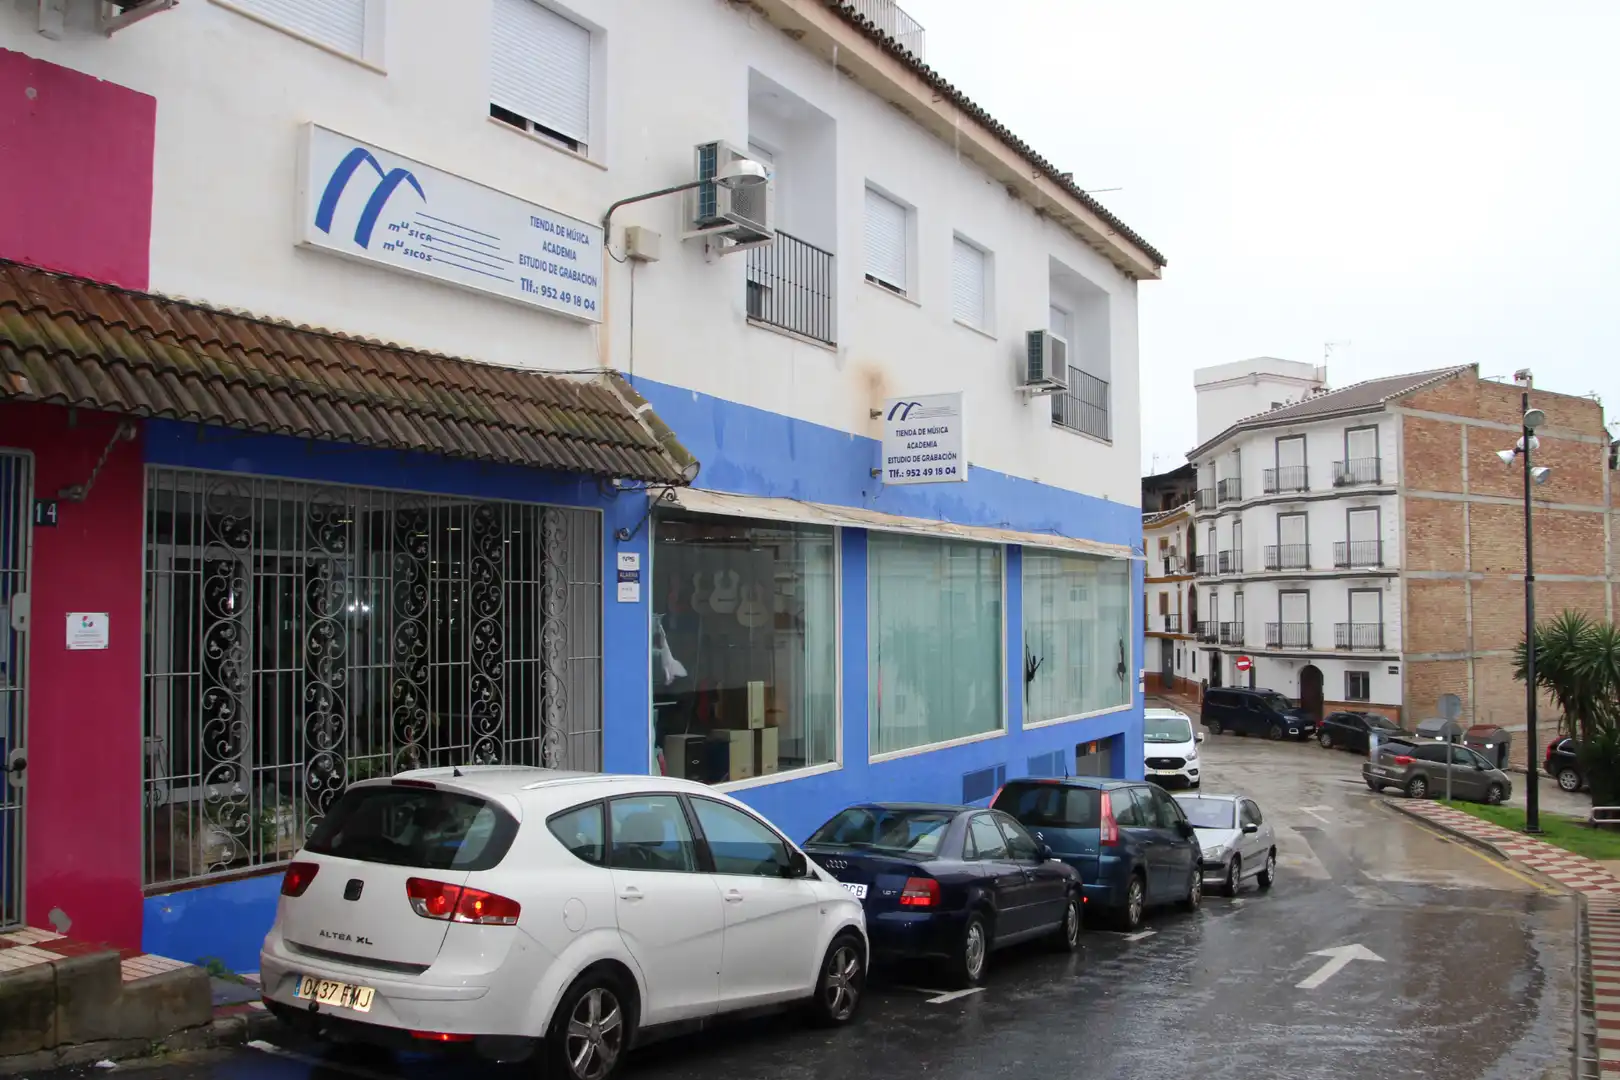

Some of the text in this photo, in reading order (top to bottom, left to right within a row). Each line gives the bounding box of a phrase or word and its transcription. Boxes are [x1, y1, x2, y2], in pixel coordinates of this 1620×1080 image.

[530, 215, 590, 245] TIENDA DE MÚSICA
[542, 240, 577, 261] ACADEMIA
[519, 254, 547, 272] ESTUDIO
[548, 262, 558, 275] DE
[520, 277, 596, 311] Tlf.: 952 49 18 04
[896, 428, 917, 437] TIENDA
[918, 427, 926, 436] DE
[906, 440, 938, 449] ACADEMIA
[888, 455, 911, 464] ESTUDIO
[912, 454, 920, 462] DE
[889, 466, 956, 478] Tlf.: 952 49 18 04
[35, 502, 57, 523] 14
[319, 929, 373, 945] ALTEA XL
[303, 978, 339, 1000] 0437
